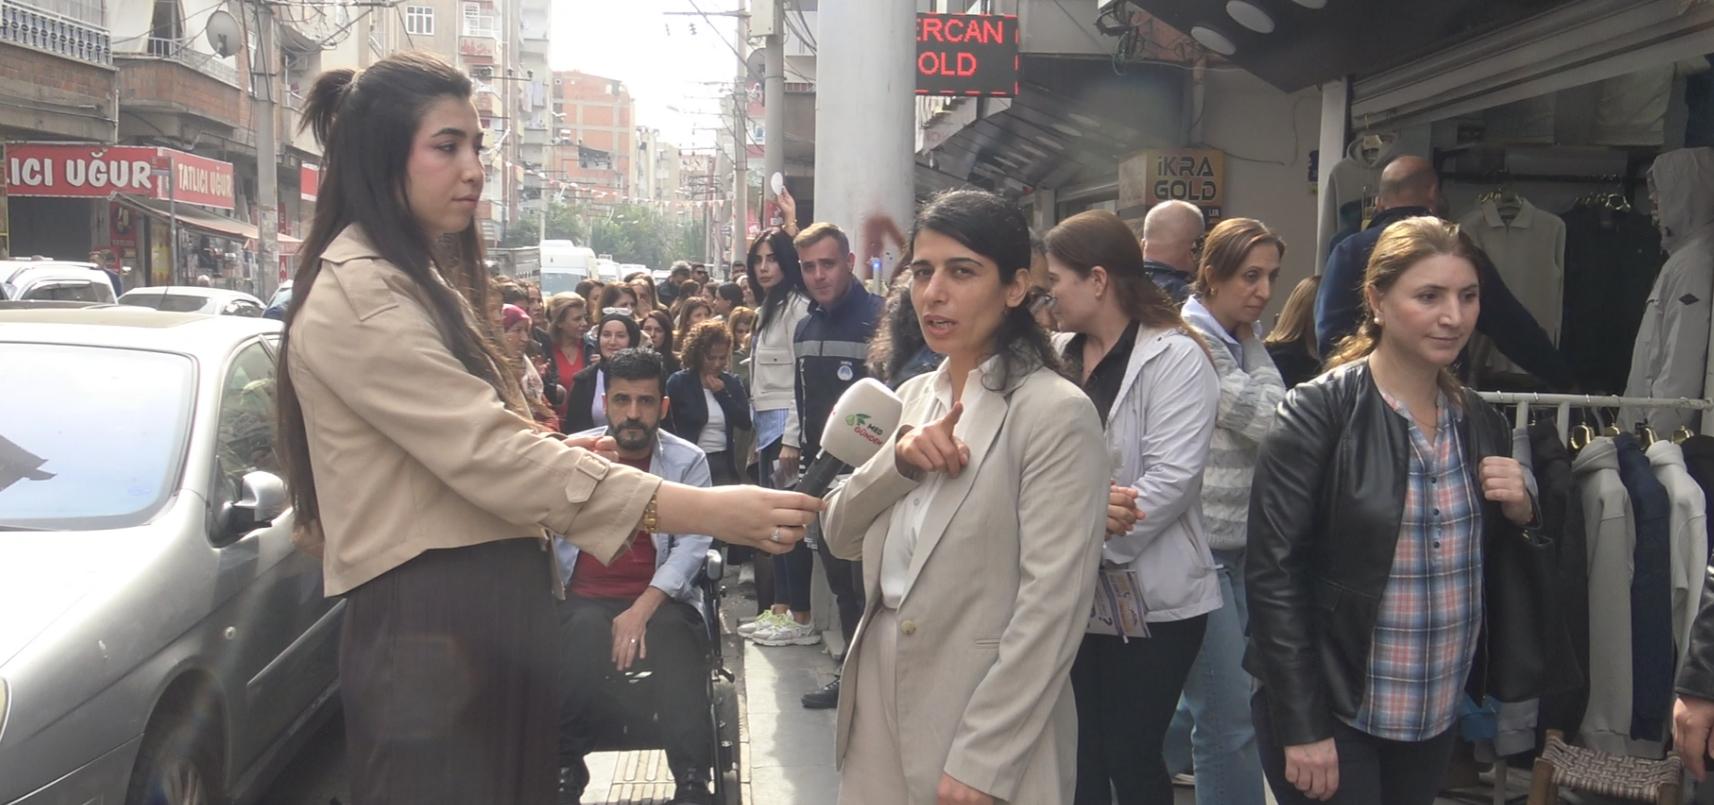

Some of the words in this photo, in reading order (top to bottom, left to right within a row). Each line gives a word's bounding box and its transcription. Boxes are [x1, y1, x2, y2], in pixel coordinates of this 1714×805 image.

[918, 51, 977, 76] OLD
[7, 157, 53, 187] ICI
[66, 151, 152, 189] UĞUR
[178, 163, 208, 195] TATLICI
[210, 166, 233, 198] UĞUR
[1154, 179, 1217, 201] GOLD
[867, 423, 883, 436] MED
